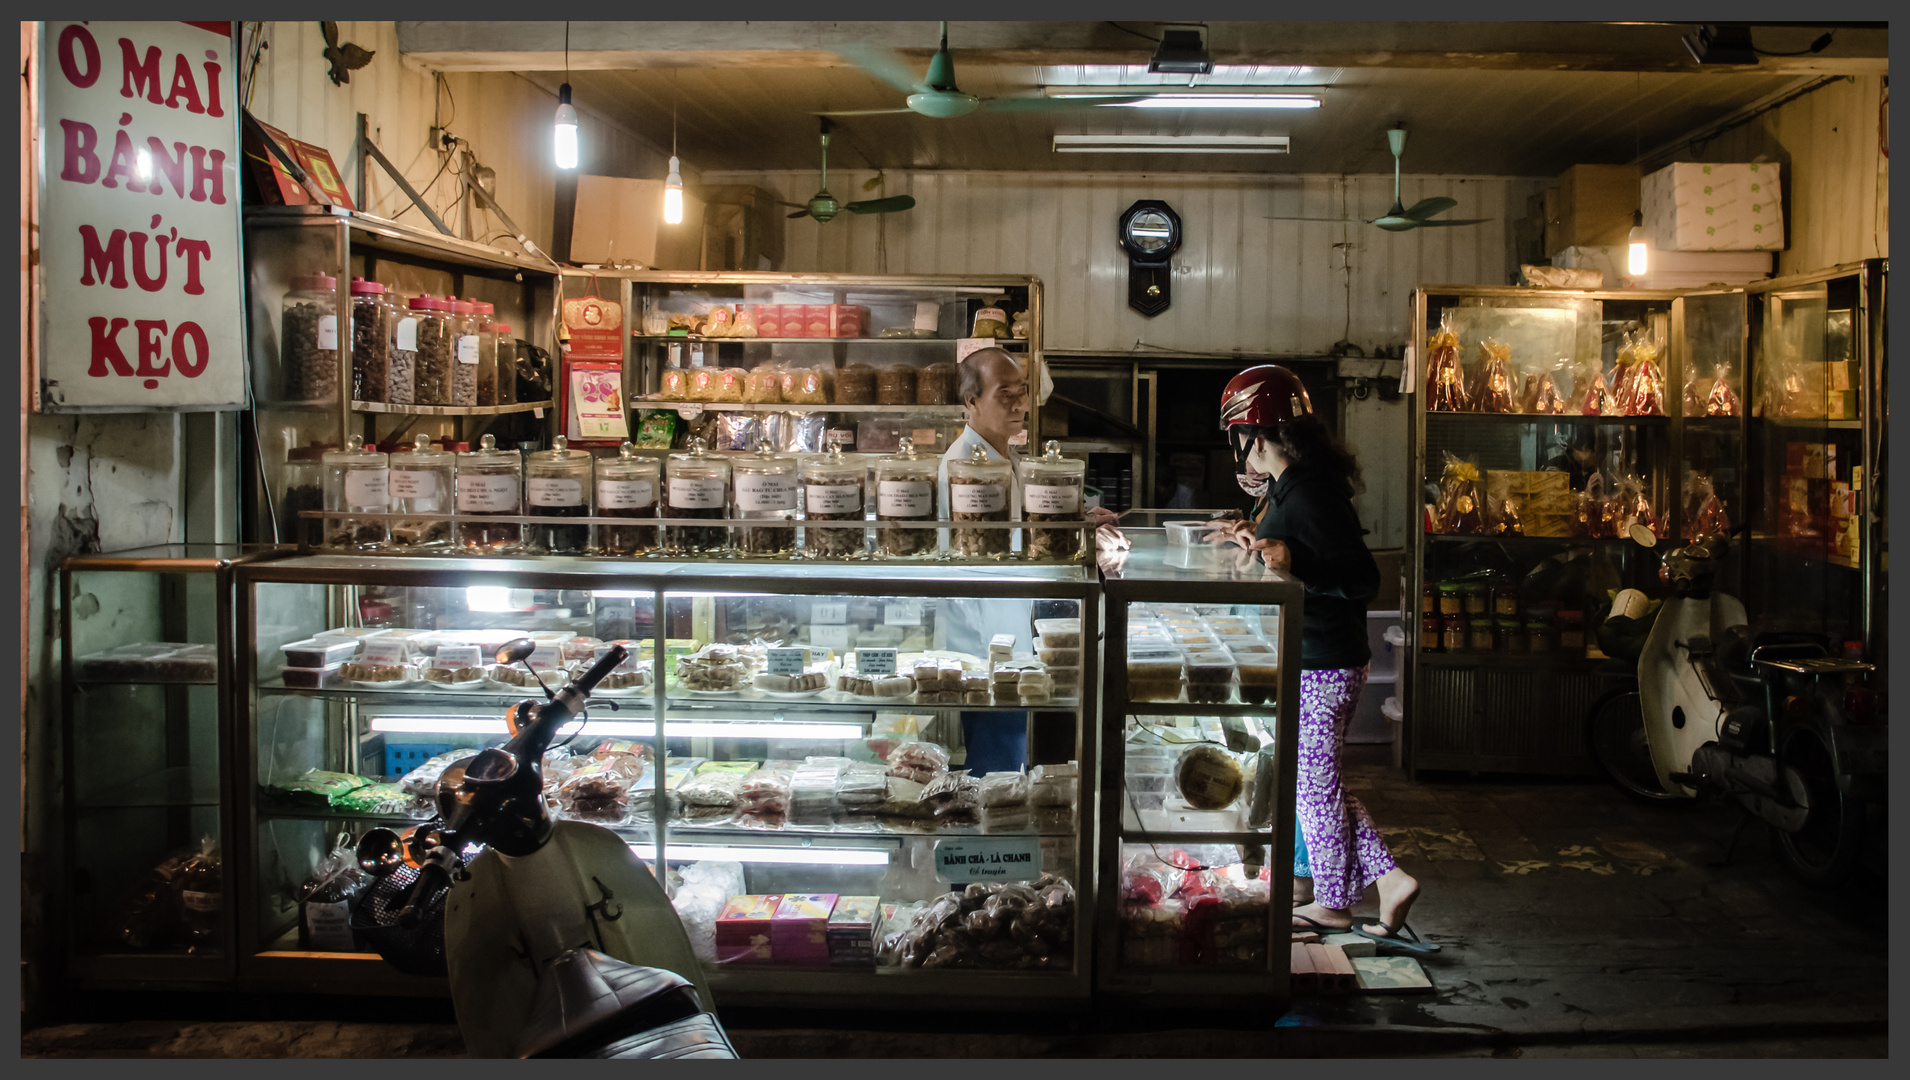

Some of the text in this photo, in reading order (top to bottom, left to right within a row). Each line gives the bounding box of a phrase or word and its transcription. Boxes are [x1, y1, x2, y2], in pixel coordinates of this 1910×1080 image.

[60, 112, 227, 205] BÁNH
[78, 213, 212, 296] MỨT
[87, 316, 210, 390] KẸO
[582, 382, 613, 403] 28
[599, 422, 610, 432] 17
[1003, 853, 1031, 863] CHANH
